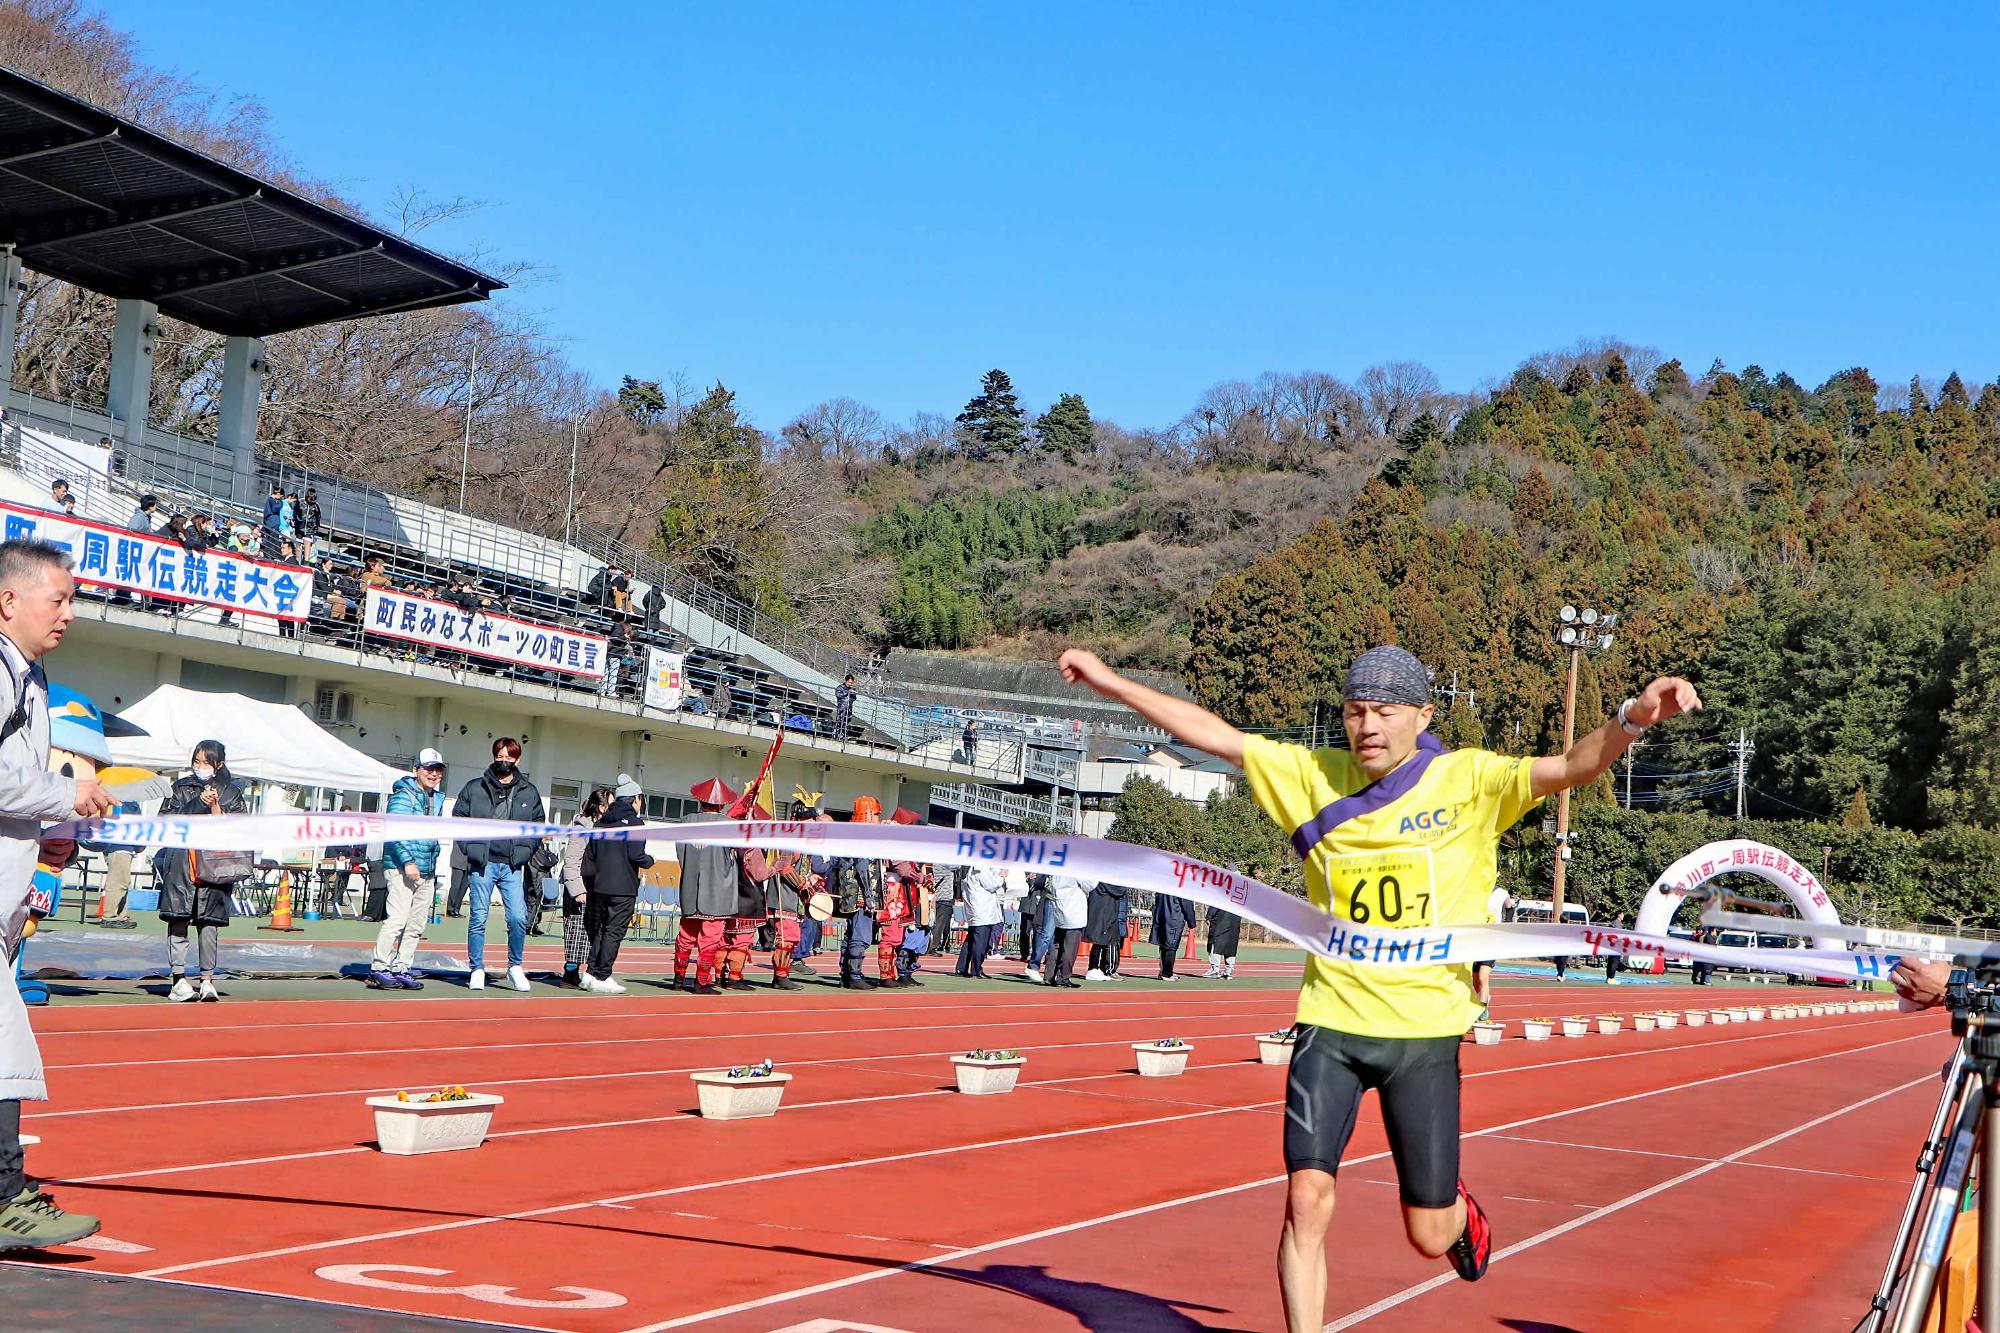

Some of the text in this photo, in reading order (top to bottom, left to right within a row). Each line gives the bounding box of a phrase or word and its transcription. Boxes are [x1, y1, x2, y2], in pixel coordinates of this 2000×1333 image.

[376, 597, 598, 669] 町民みなスポーツの町宣言
[1400, 808, 1448, 834] AGC
[957, 832, 1068, 867] FINISH
[1172, 860, 1249, 906] Finish
[1350, 875, 1430, 923] 60-7
[1327, 926, 1452, 963] FINISH
